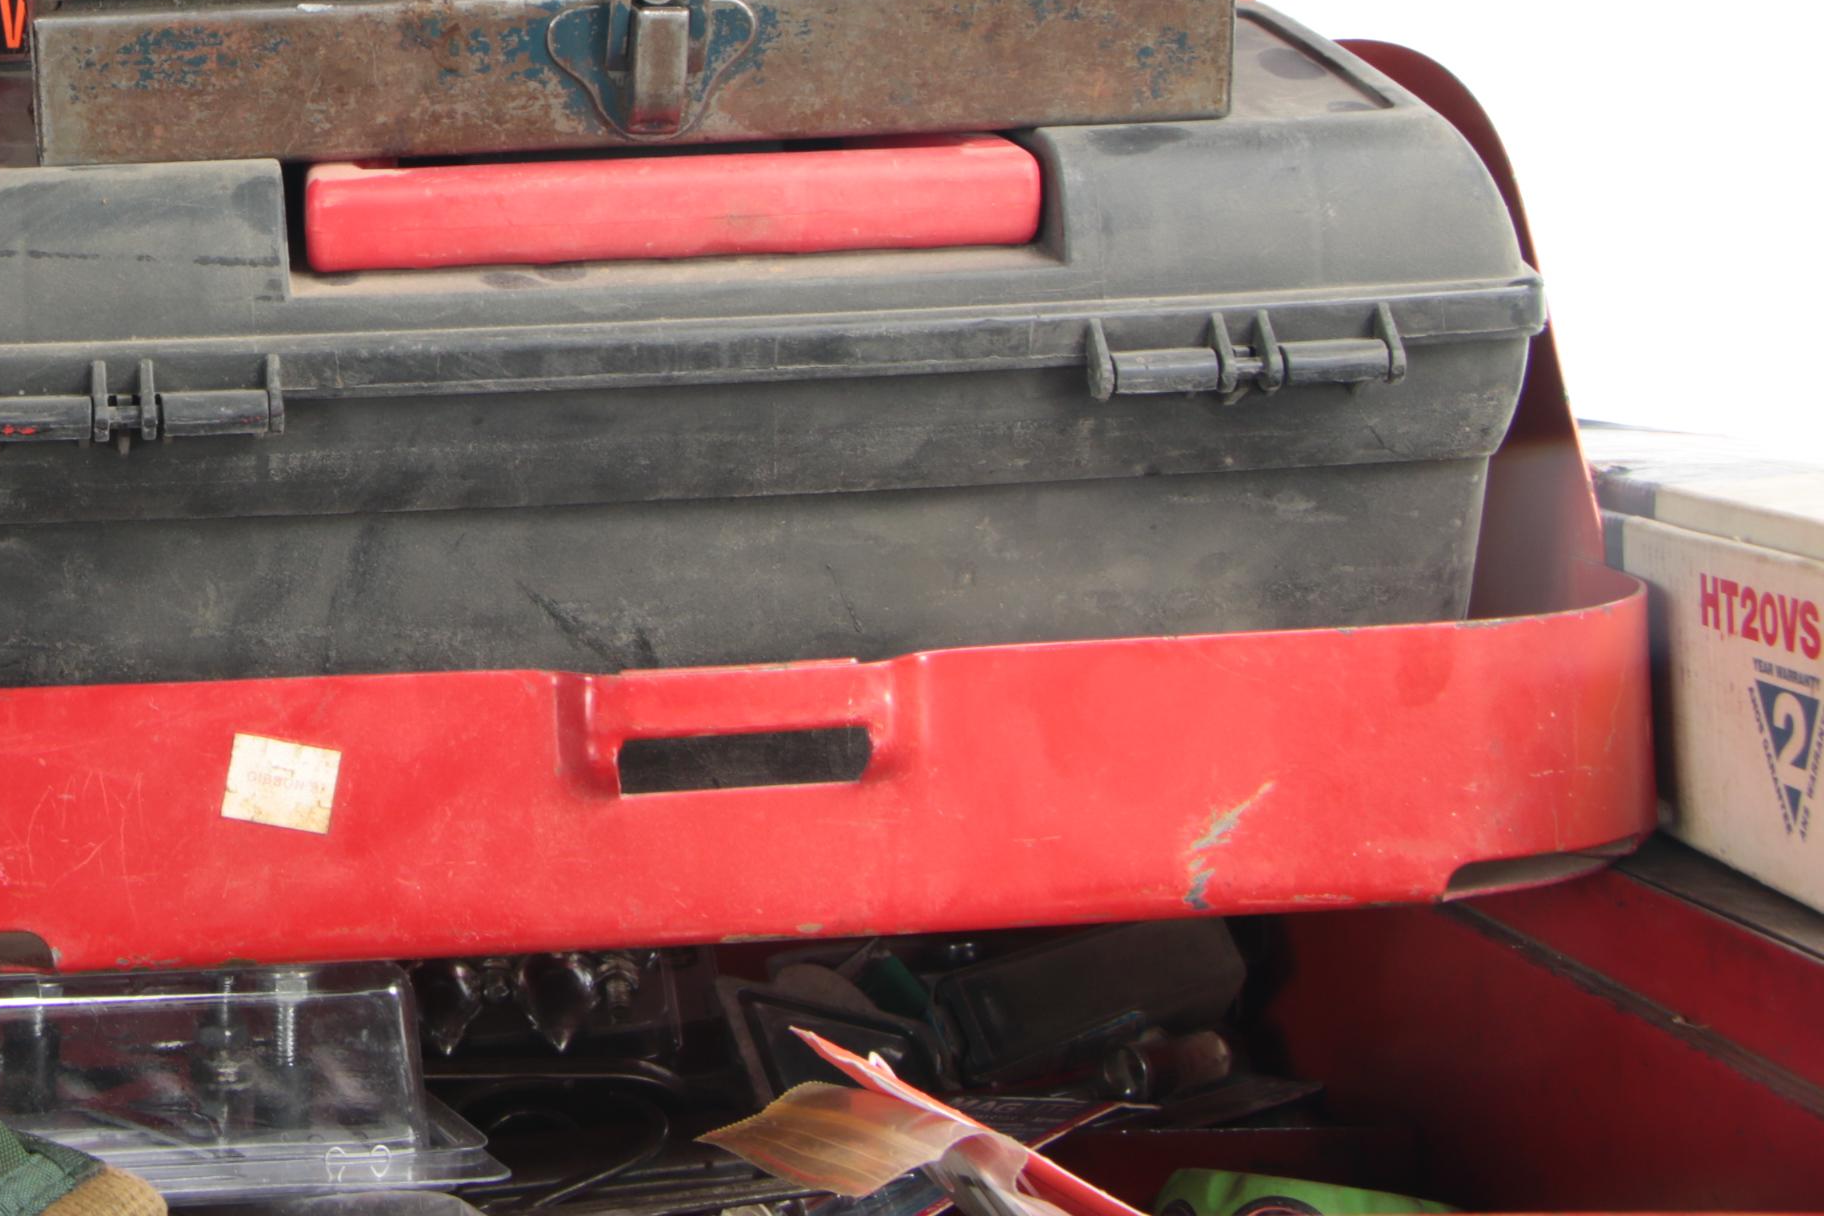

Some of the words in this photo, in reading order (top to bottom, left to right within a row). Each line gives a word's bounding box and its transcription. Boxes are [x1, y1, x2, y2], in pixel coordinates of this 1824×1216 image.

[1700, 572, 1822, 661] HT20VS
[1753, 657, 1774, 676] YEAR
[1773, 691, 1807, 782] 2
